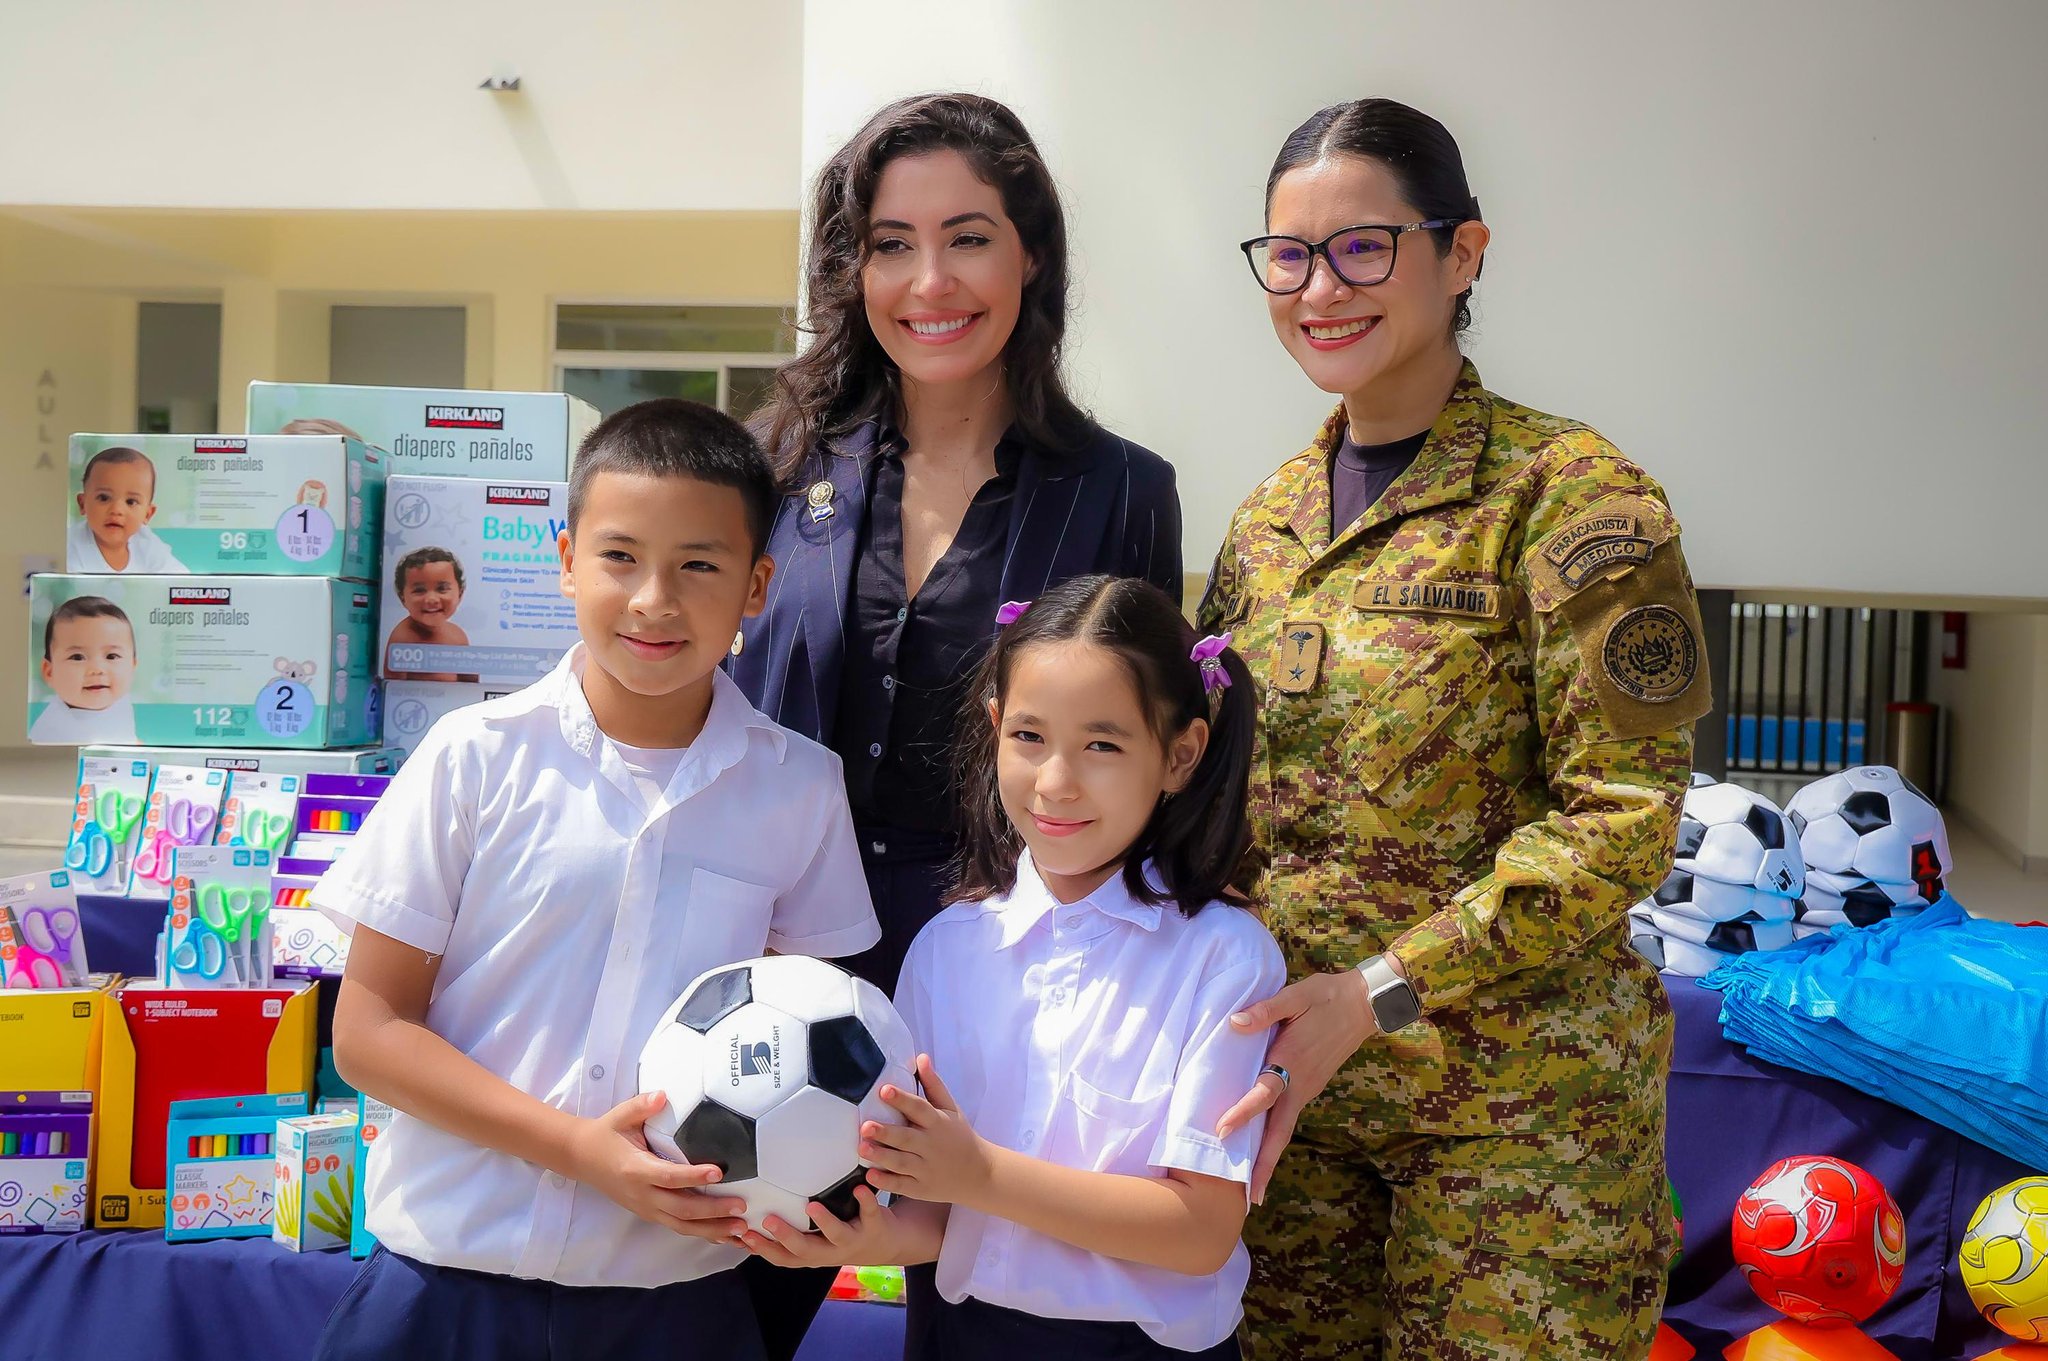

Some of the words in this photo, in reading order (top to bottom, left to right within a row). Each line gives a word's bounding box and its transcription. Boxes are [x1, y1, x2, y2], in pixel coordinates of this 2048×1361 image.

[428, 407, 502, 422] KIRKLAND
[196, 440, 247, 449] KIRKLAND
[394, 433, 456, 460] diapers
[469, 437, 533, 462] pañales
[177, 456, 216, 472] diapers
[223, 457, 264, 473] pañales
[488, 487, 549, 500] KIRKLAND
[297, 509, 309, 533] 1
[220, 531, 248, 549] 96
[1552, 519, 1629, 556] PARACAIDISTA
[482, 552, 561, 563] FRAGRAN
[1574, 542, 1636, 571] MEDICO
[171, 589, 230, 599] KIRKLAND
[1373, 585, 1391, 605] EL
[1399, 585, 1487, 614] SALVADOR
[149, 607, 195, 627] diapers
[203, 608, 250, 627] pañales
[392, 648, 424, 662] 900
[276, 686, 294, 710] 2
[193, 707, 232, 725] 112
[731, 1034, 739, 1086] OFFICIAL
[308, 1135, 354, 1147] HIGHLIGHTERS
[176, 1173, 203, 1182] CLASSIC
[176, 1181, 208, 1190] MARKERS
